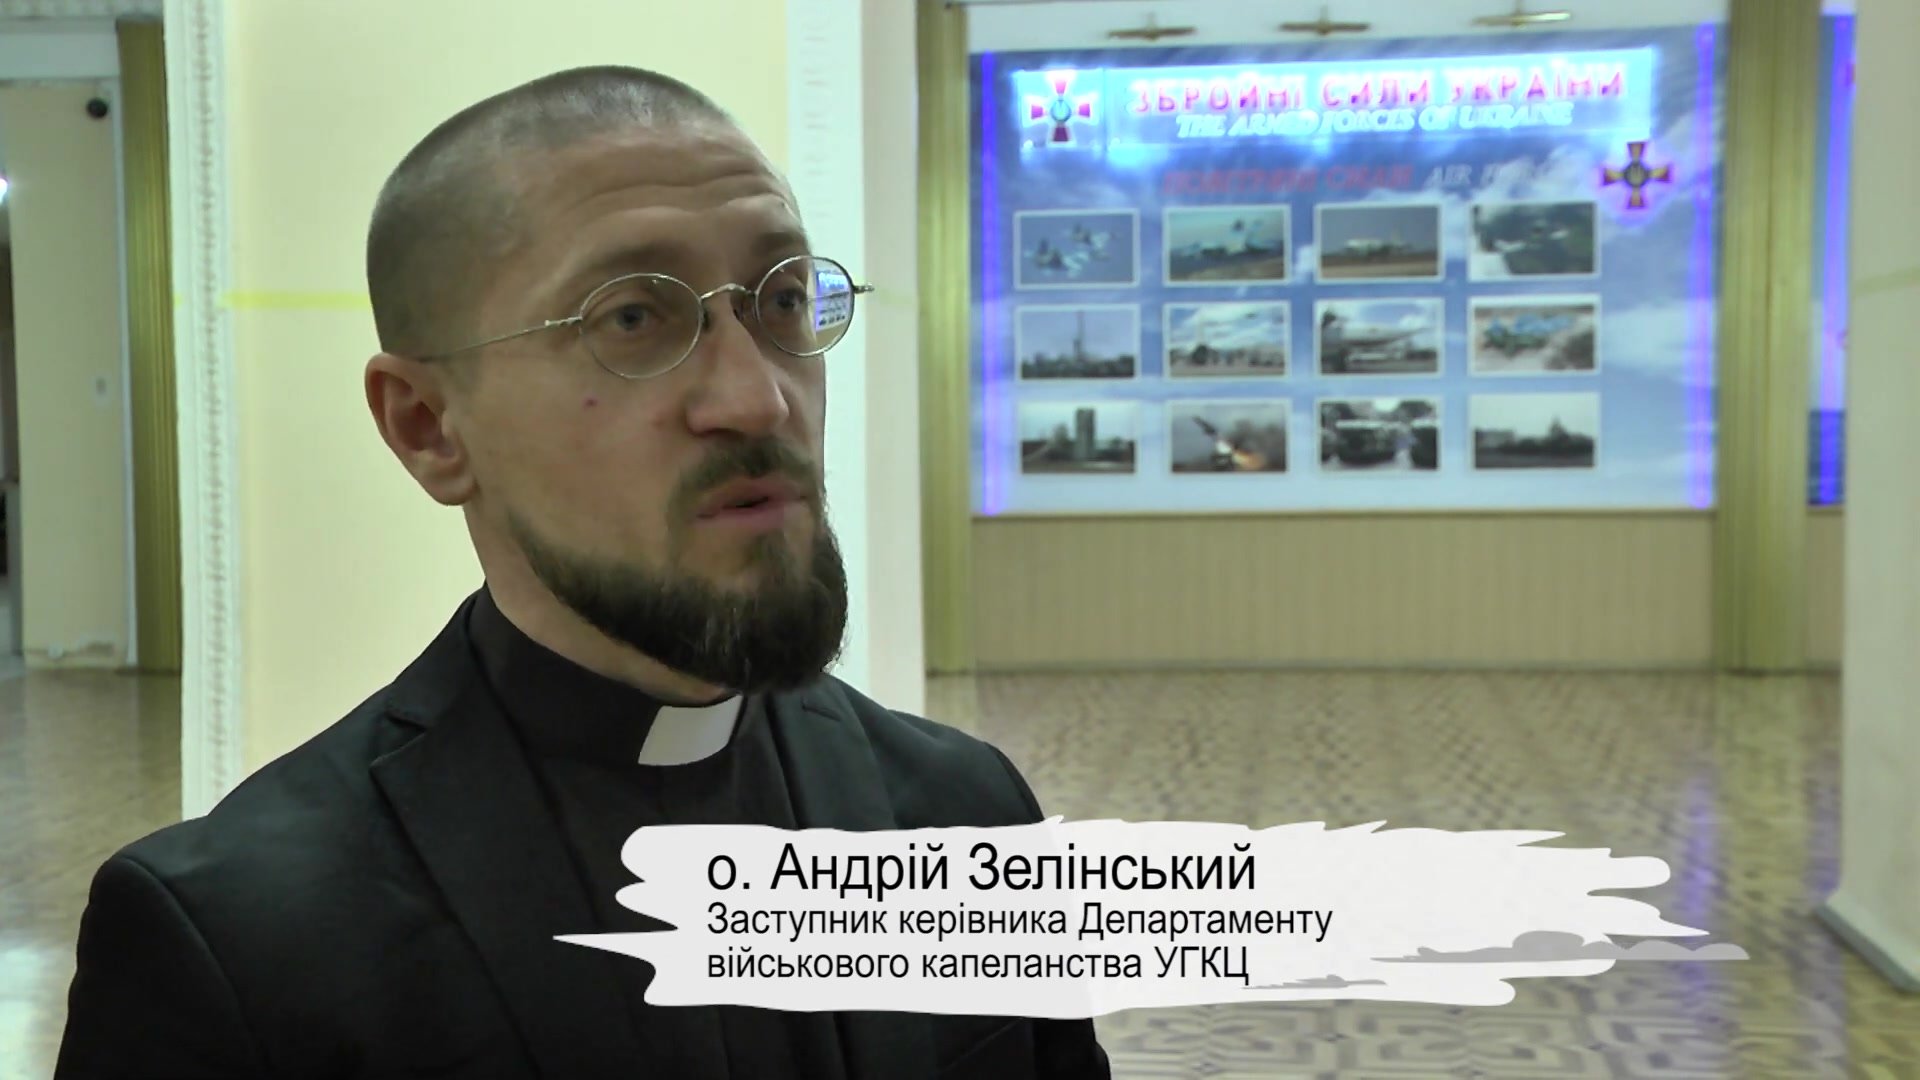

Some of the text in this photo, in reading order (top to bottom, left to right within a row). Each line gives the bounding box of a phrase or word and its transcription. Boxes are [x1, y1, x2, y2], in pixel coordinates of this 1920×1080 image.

[1128, 62, 1624, 112] ЗБРОЙНІ СИЛИ УКРАЇНИ
[1177, 114, 1226, 137] THE
